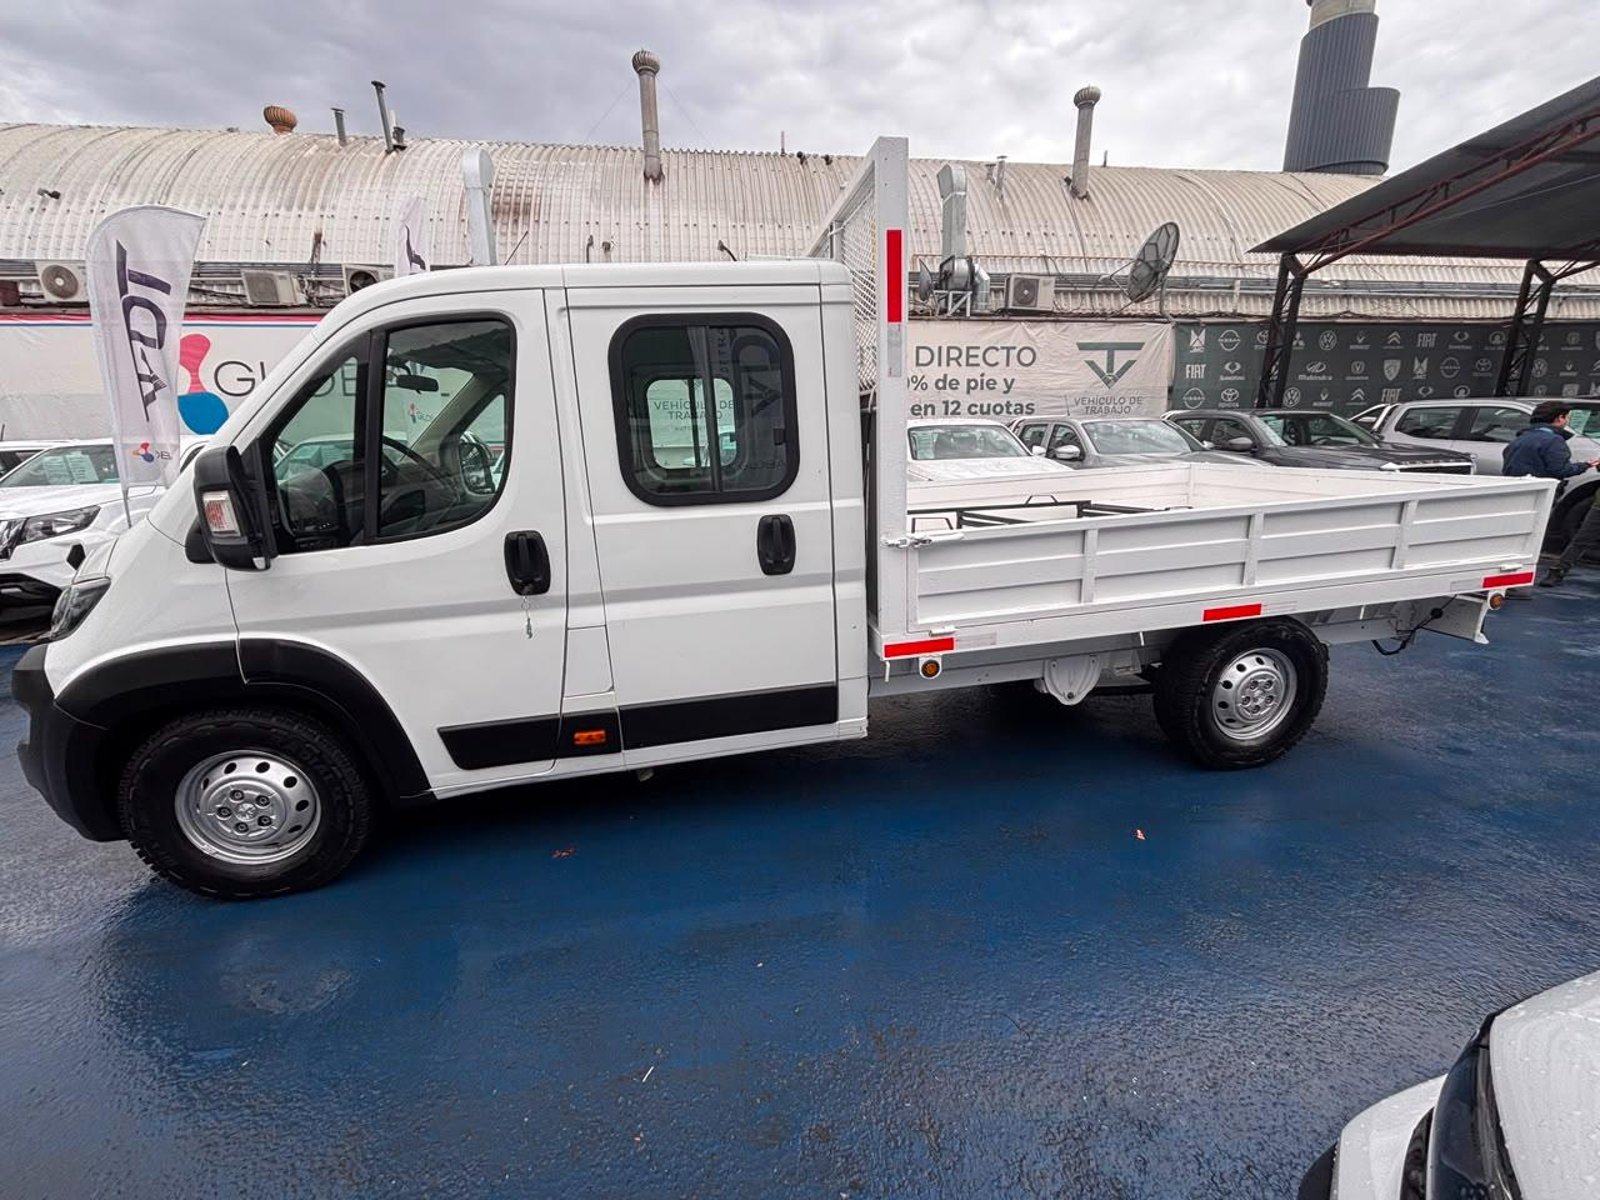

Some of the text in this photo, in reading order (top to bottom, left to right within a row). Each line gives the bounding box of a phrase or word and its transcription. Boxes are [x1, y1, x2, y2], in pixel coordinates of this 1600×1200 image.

[915, 345, 1037, 368] DIRECTO
[1185, 363, 1207, 379] FIAT
[934, 373, 960, 390] de
[1002, 377, 1016, 394] y
[653, 398, 709, 410] VEHÍCL
[910, 400, 1036, 416] en 12 cuotas
[1129, 396, 1144, 405] DE
[1085, 405, 1132, 415] TRABAJO
